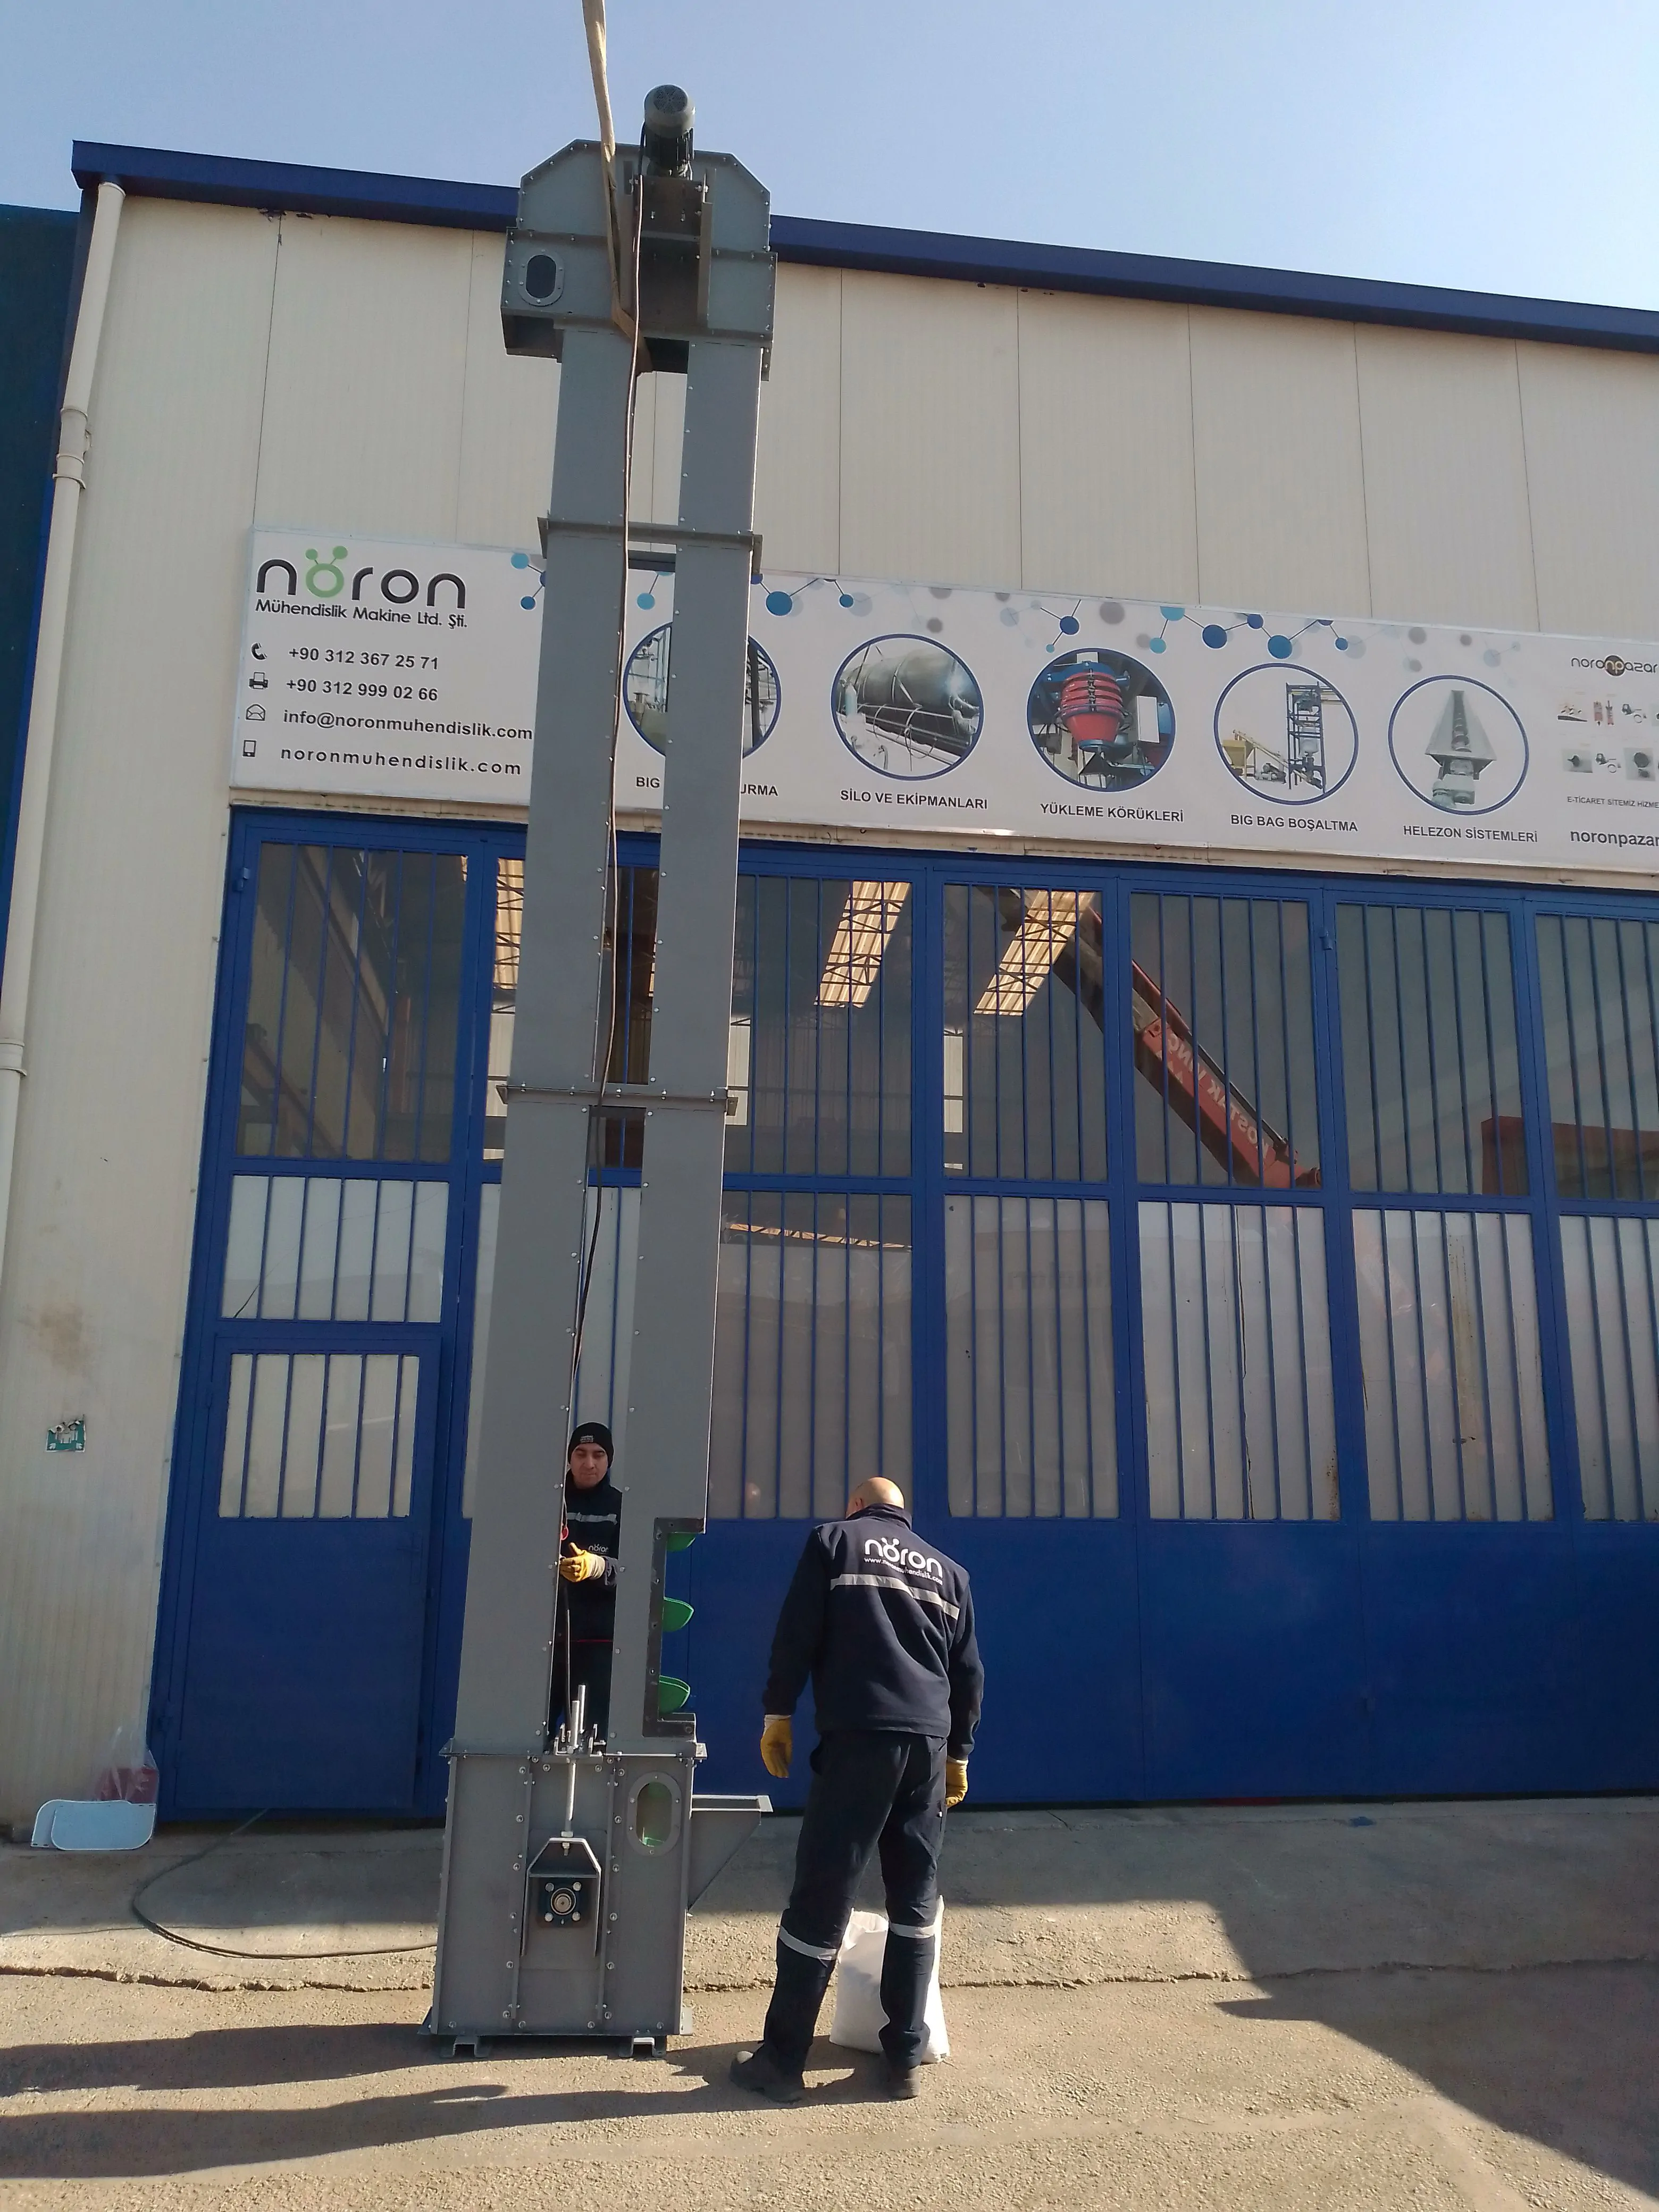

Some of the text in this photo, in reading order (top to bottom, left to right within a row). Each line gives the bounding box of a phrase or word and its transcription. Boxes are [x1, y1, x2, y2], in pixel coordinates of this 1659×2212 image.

[255, 599, 467, 629] Mühendislik Makine Ltd. Şti.
[289, 647, 438, 670] +90 312 367 25 71
[286, 679, 438, 701] +90 312 999 02 66
[283, 709, 532, 740] info@noronmuhendislik.com
[280, 748, 521, 775] noronmuhendislik.com
[636, 776, 778, 797] BIG URMA
[840, 788, 987, 809] SİLO VE EKİPMANLARI
[1567, 795, 1605, 805] E-TİCARET
[1607, 799, 1636, 807] SİTEMİZ
[1040, 802, 1184, 822] YÜKLEME KÖRÜKLERİ
[1230, 814, 1358, 832] BIG BAG BOŞALTMA
[1403, 825, 1538, 842] HELEZON SİSTEMLERİ
